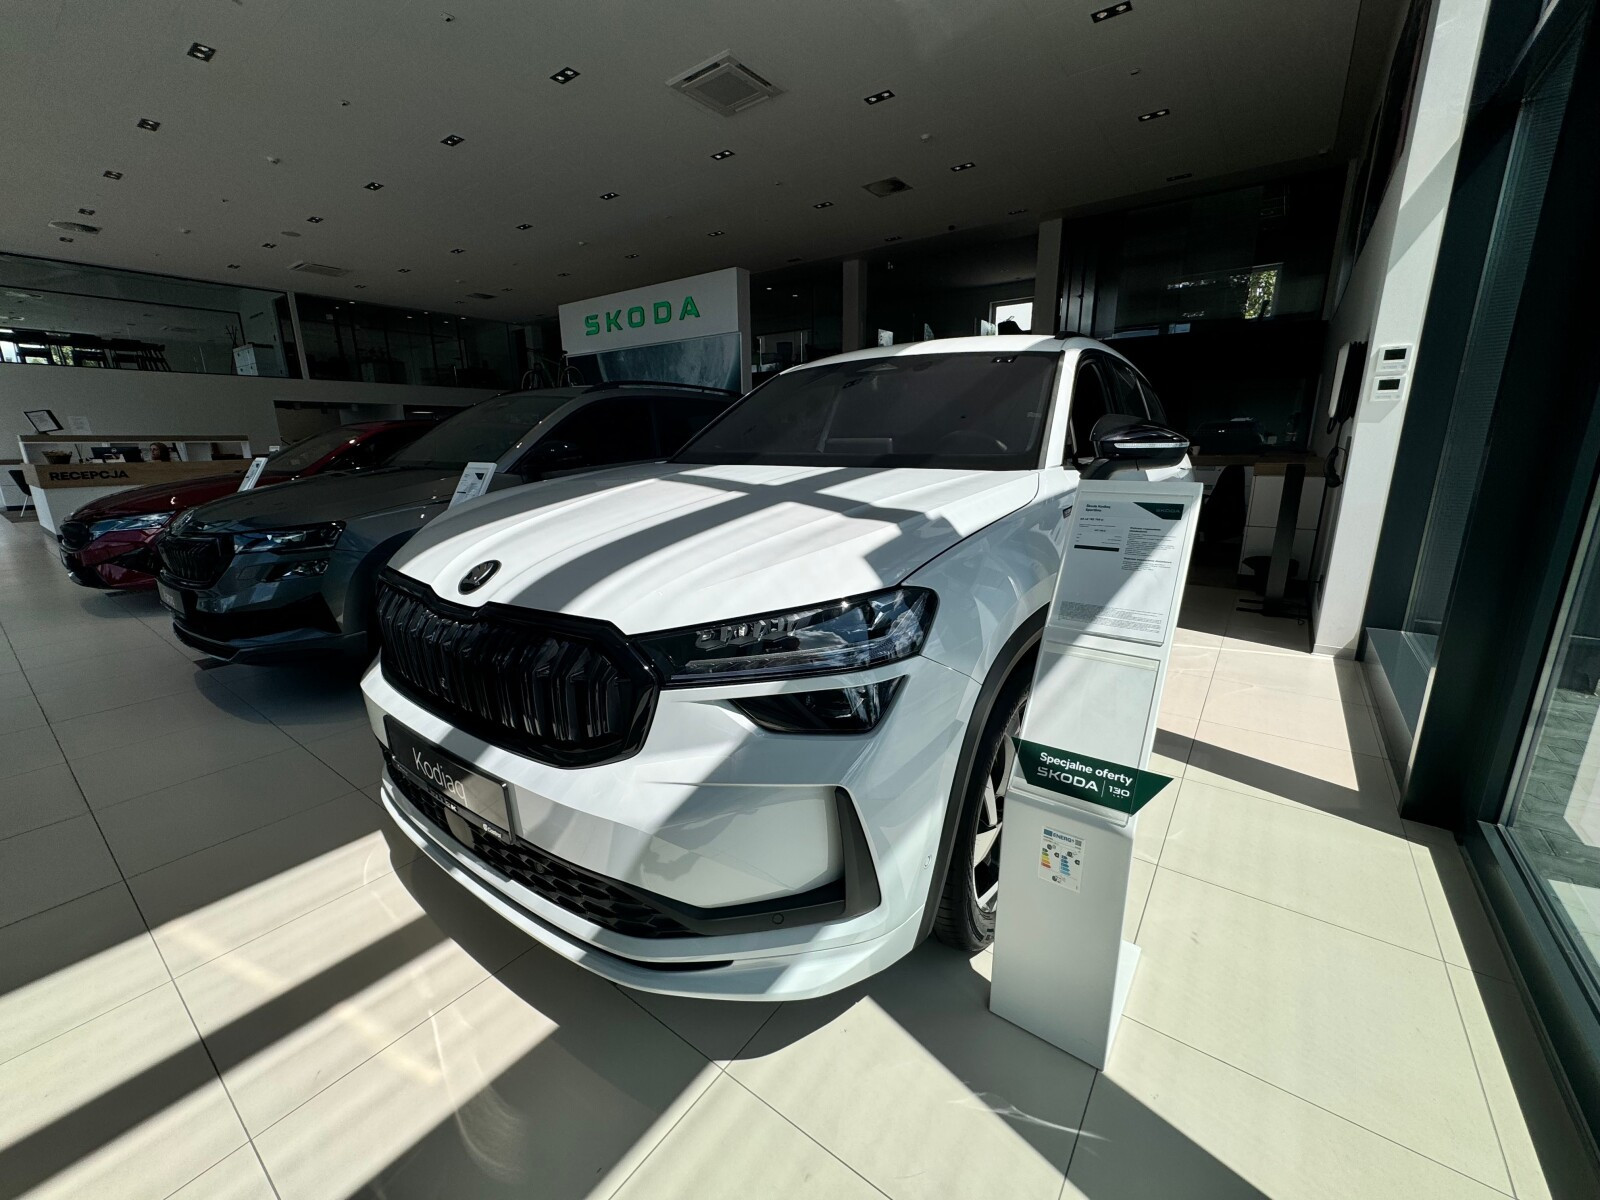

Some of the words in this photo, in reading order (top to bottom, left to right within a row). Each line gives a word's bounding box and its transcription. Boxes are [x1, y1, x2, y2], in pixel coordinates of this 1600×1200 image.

[49, 470, 130, 482] RECEPCJA
[412, 747, 468, 807] Kodiaq
[1039, 752, 1093, 775] Specjalne
[1095, 768, 1133, 787] oferty
[1108, 785, 1130, 797] 130
